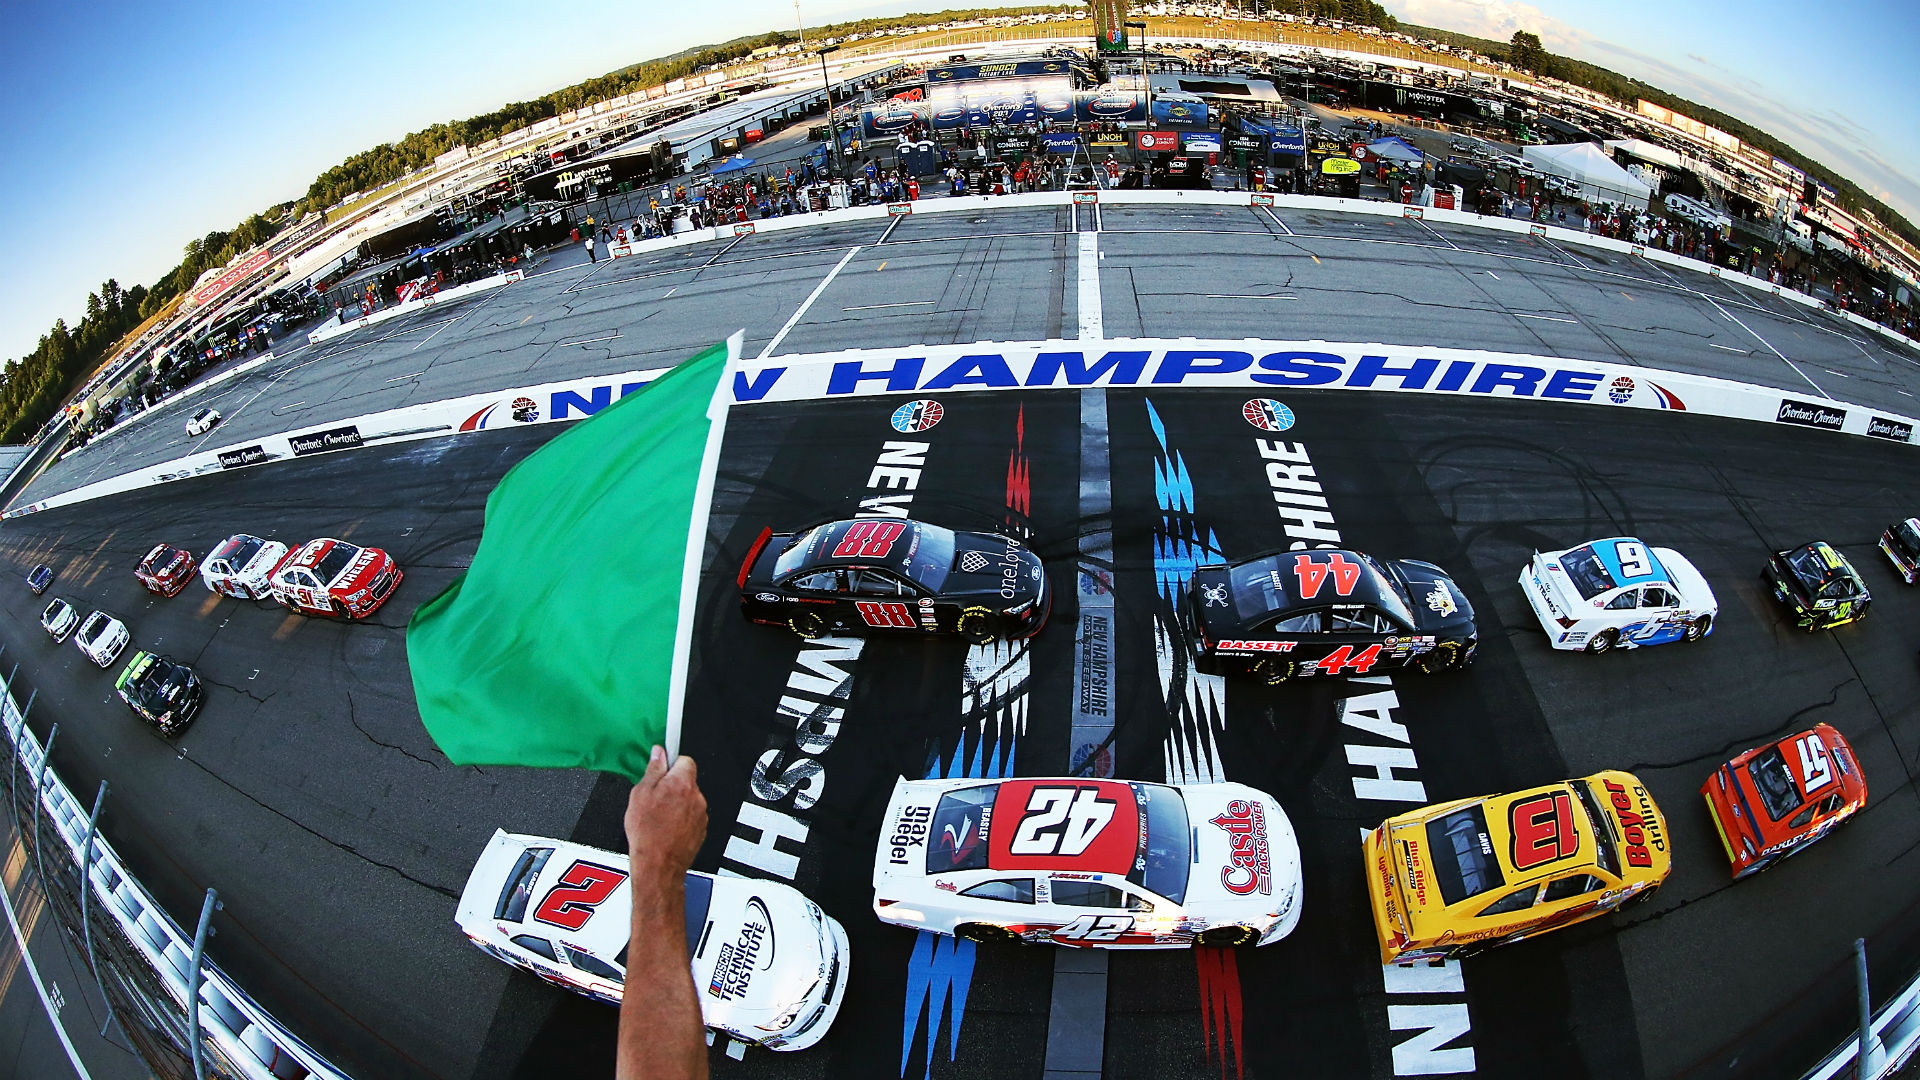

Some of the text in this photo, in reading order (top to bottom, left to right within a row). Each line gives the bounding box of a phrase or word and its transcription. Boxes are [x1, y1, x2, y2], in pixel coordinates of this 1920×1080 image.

[980, 63, 1018, 73] SUNOCO
[1408, 92, 1446, 104] MONSTER
[996, 141, 1030, 149] CONNECT
[1097, 133, 1122, 141] UNOH
[1228, 140, 1260, 148] CONNECT
[1271, 141, 1305, 151] Overton's
[1317, 141, 1341, 150] UNOH
[574, 164, 612, 179] MONSTER
[222, 252, 268, 284] TOYOTA
[826, 350, 1606, 402] HAMPSHIRE
[1779, 403, 1844, 426] Overton's Overton's
[1868, 420, 1891, 435] Overton's
[291, 431, 360, 454] Overton's Overton's
[220, 456, 242, 468] Overton's
[831, 520, 907, 559] 88
[333, 549, 380, 590] WHELEN
[1293, 552, 1362, 600] 44
[854, 600, 917, 628] 88
[1538, 584, 1557, 614] TELMEX
[1834, 601, 1852, 620] 30
[1632, 610, 1673, 641] 6
[1217, 640, 1298, 652] BASSETT
[1317, 643, 1384, 675] 44
[1091, 615, 1108, 718] NEW HAMPSHIRE
[1080, 653, 1092, 715] SPEEDWAY
[889, 805, 914, 865] Siegel
[908, 805, 931, 848] max
[978, 806, 992, 841] BEASLEY
[1009, 784, 1118, 857] 42
[1507, 789, 1580, 872] 13
[1602, 778, 1653, 868] Boyer
[1632, 786, 1665, 852] drilling
[1140, 836, 1148, 850] PRO
[1208, 799, 1259, 895] Castle
[1252, 801, 1270, 877] PACKS POWER
[1477, 832, 1492, 855] DAVIS
[1378, 856, 1393, 898] Lightning
[1408, 840, 1427, 906] Blue Ridge
[532, 858, 629, 932] 2
[1052, 914, 1135, 942] 42
[1432, 928, 1497, 946] Overstock
[712, 943, 735, 985] NASCAR
[721, 921, 755, 1002] TECHNICAL
[735, 922, 766, 999] INSTITUTE
